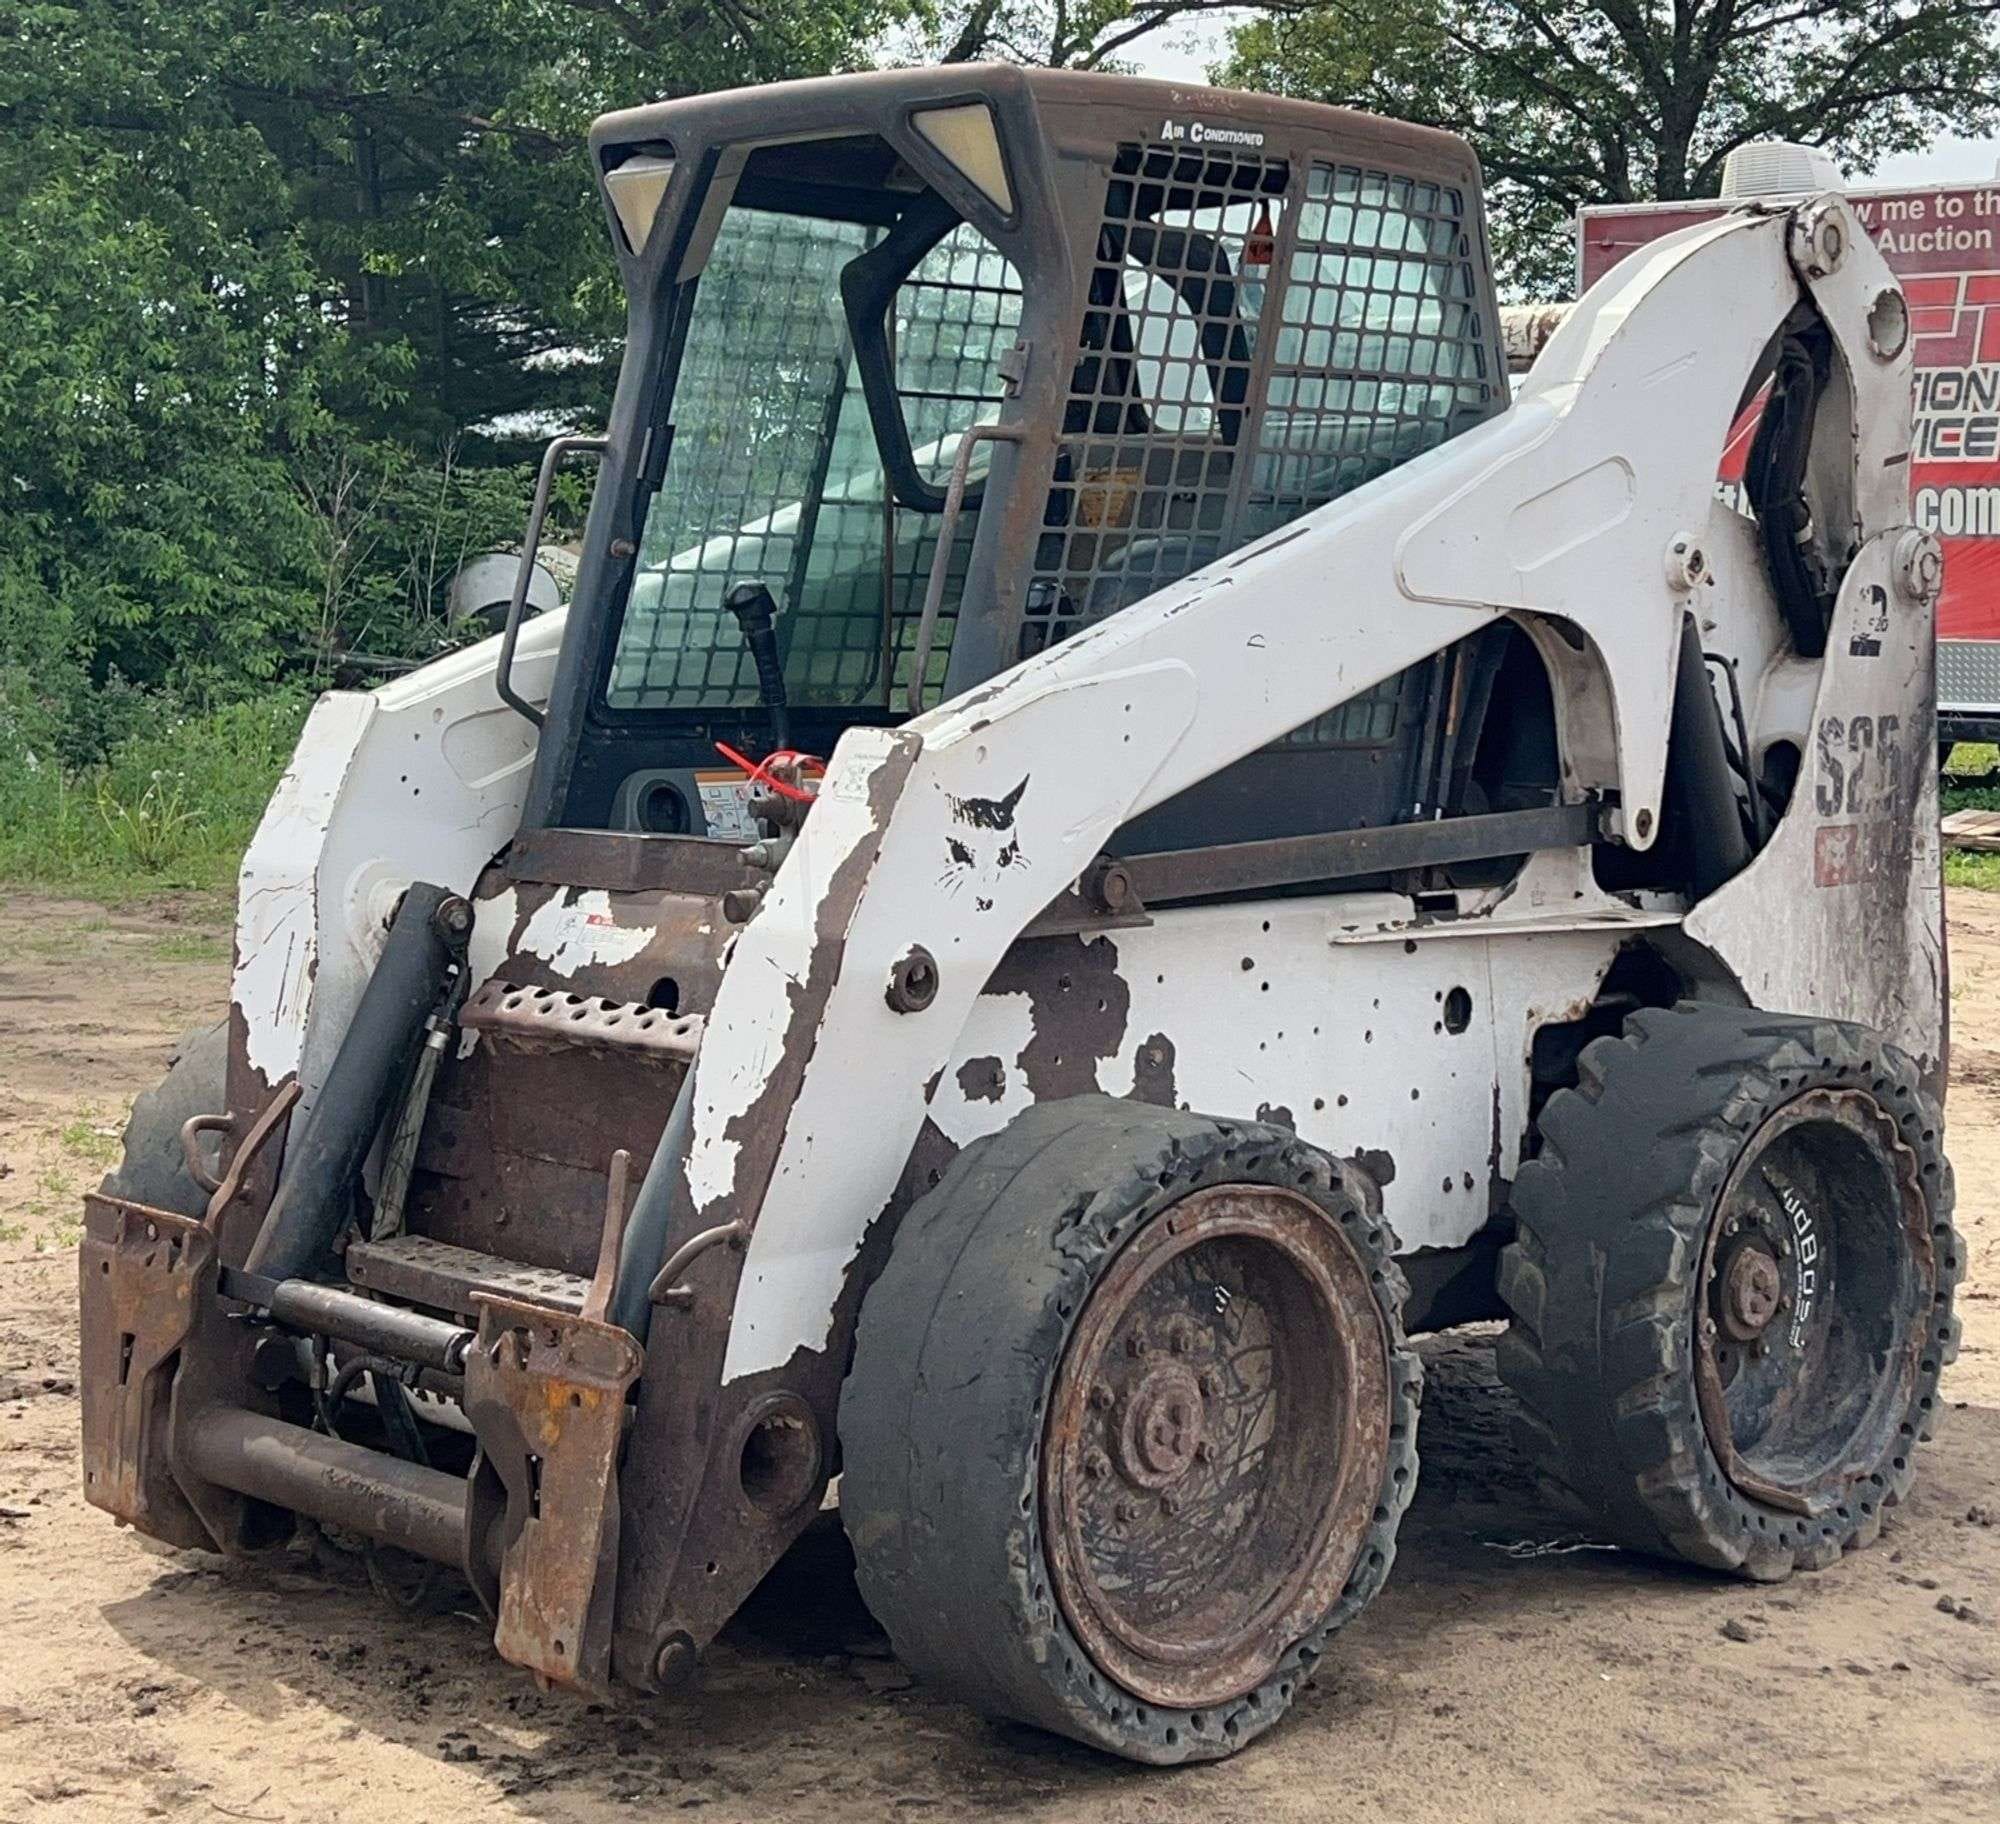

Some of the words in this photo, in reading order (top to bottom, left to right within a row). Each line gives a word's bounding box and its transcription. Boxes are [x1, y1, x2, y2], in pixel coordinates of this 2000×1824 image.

[1881, 200, 1925, 221] me
[1935, 194, 1965, 218] to
[1878, 224, 1992, 254] Auction
